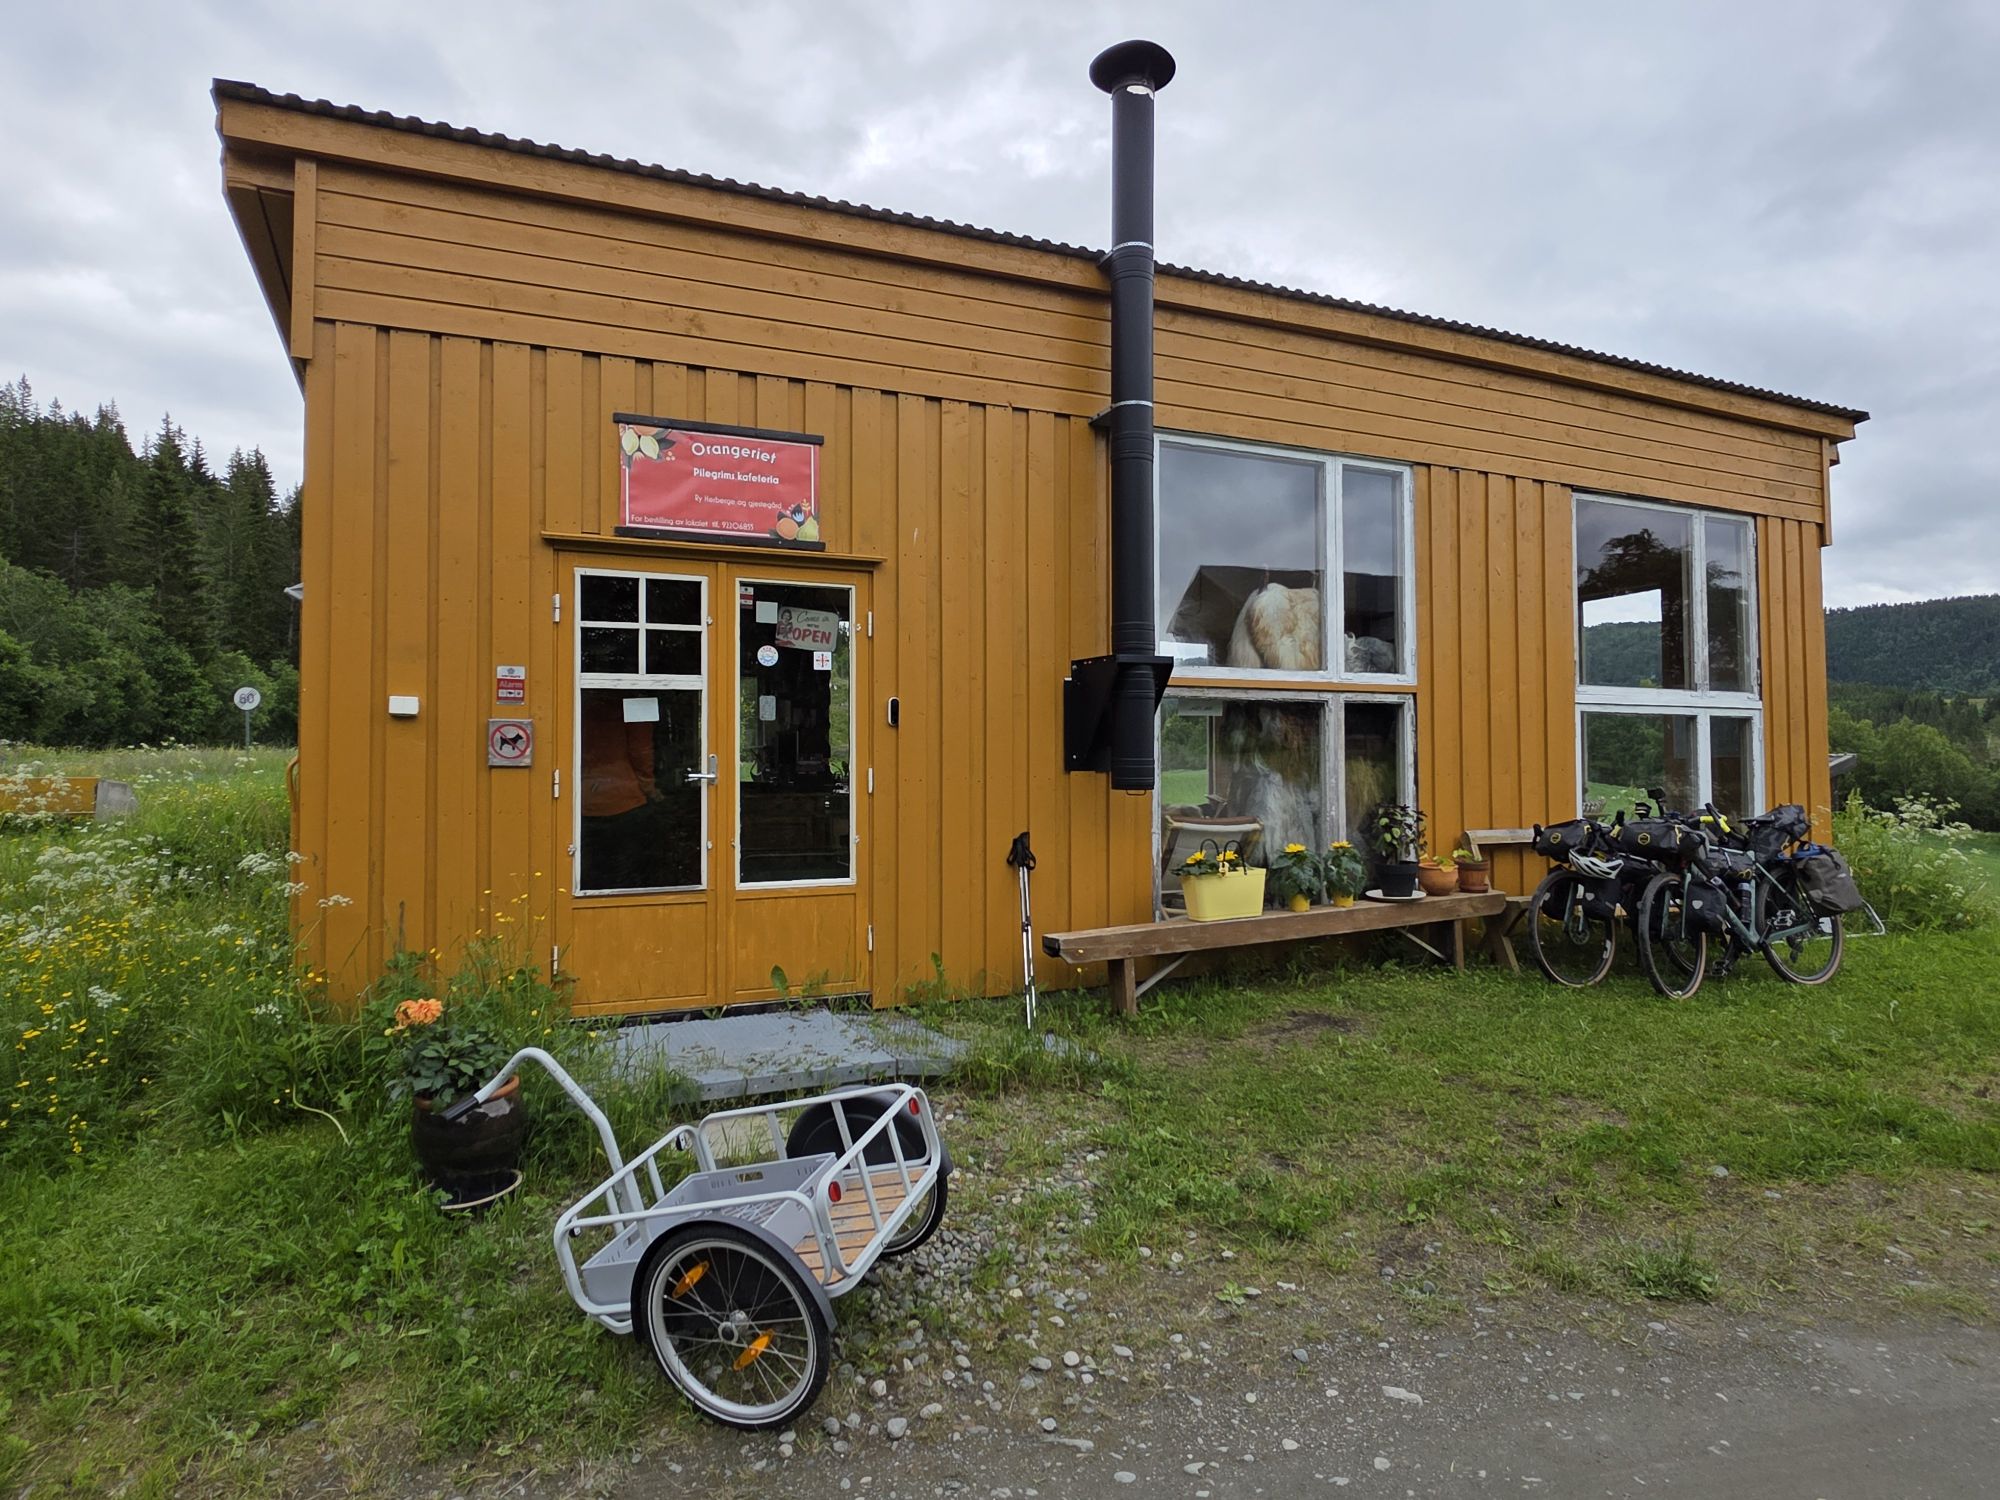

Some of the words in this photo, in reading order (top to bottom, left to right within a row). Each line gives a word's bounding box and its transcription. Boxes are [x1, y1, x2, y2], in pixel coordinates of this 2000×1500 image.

[692, 442, 776, 464] Orangeriet
[693, 467, 735, 480] Pilegrims
[737, 471, 779, 484] kafeteria
[631, 514, 642, 522] For
[644, 515, 674, 525] bestilling
[685, 518, 708, 527] lokalet
[792, 628, 831, 644] OPEN
